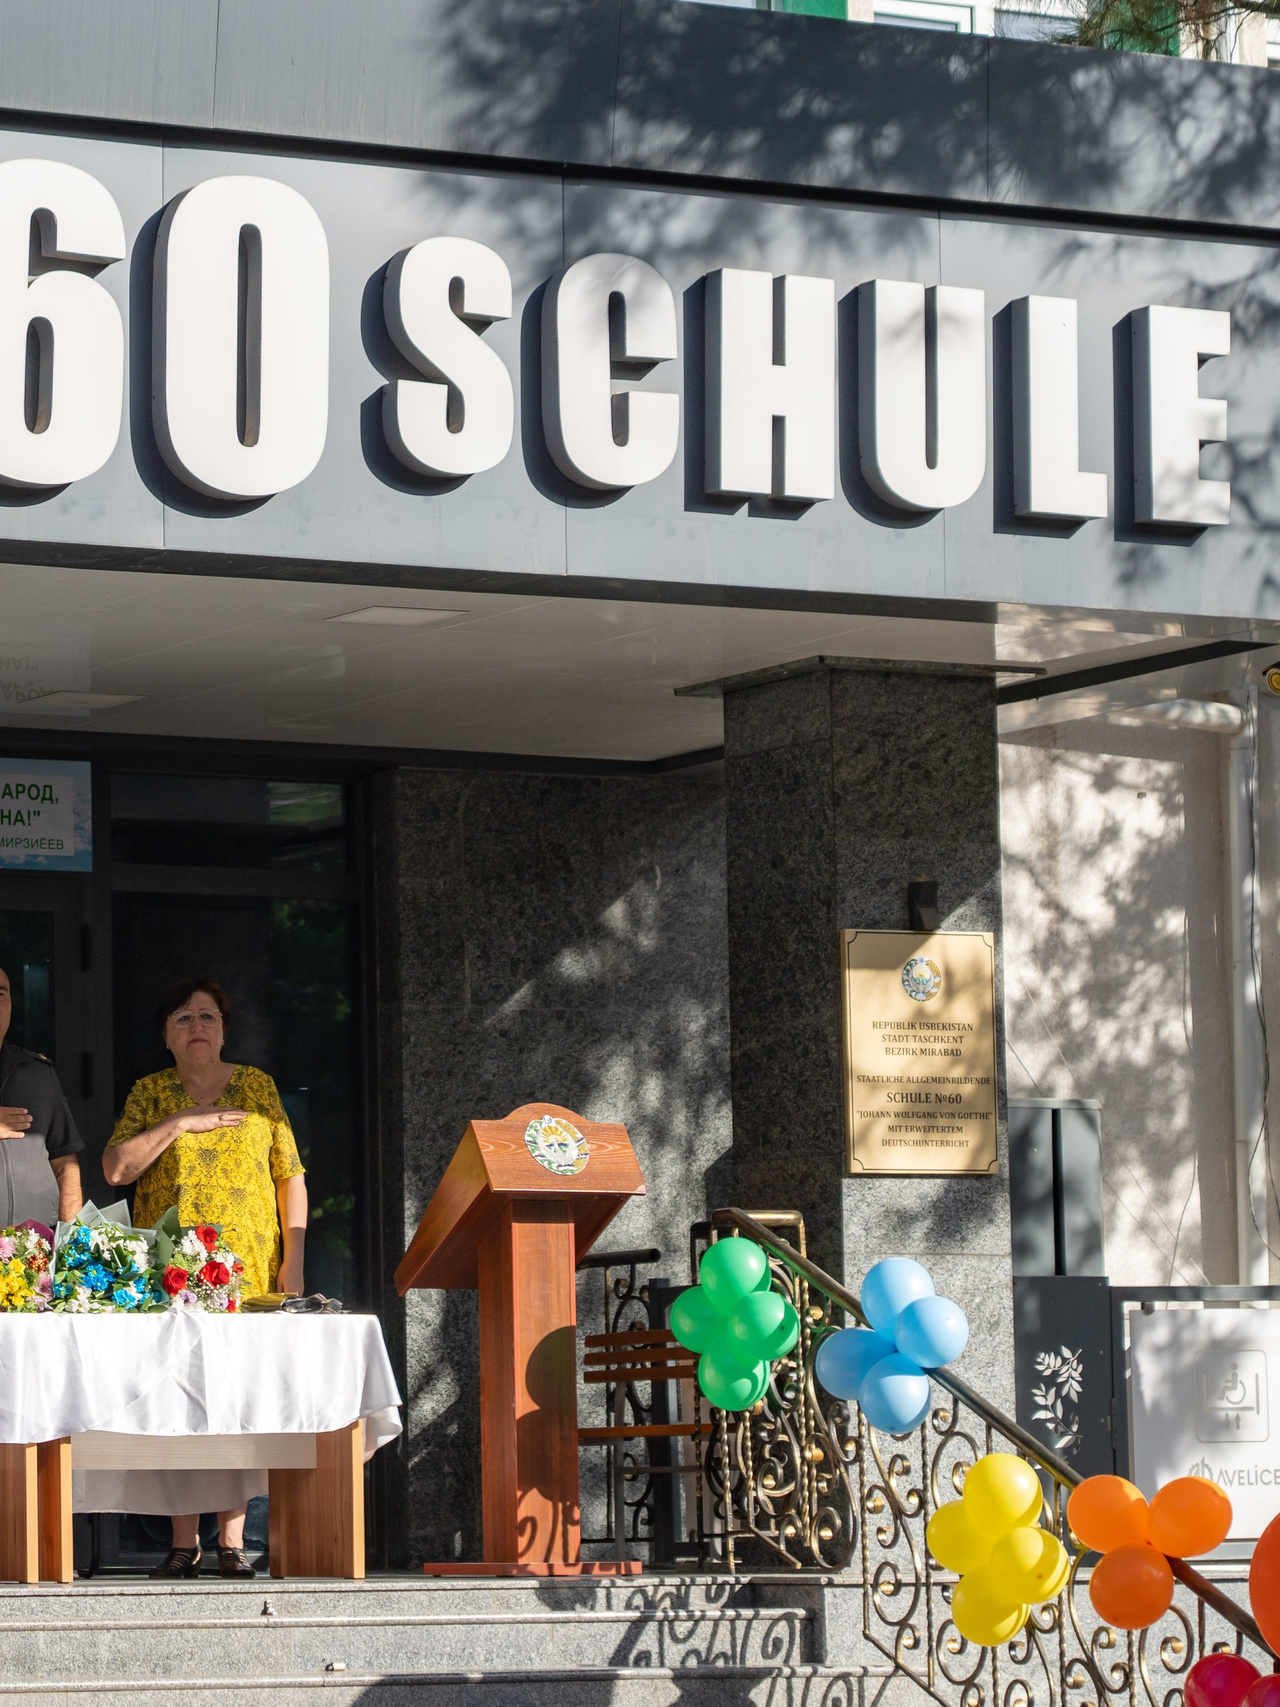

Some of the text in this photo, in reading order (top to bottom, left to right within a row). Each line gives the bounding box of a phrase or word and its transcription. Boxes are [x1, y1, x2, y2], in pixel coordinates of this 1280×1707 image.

[380, 236, 1233, 530] SCHULE
[872, 1020, 974, 1032] REPUBLIK USBEKISTAN
[881, 1034, 965, 1044] STADT TASCHKENT
[885, 1047, 962, 1057] BEZIRK MIRABAD
[856, 1074, 992, 1085] STAATLICHE ALLGEMEINBILDENDE
[886, 1091, 932, 1104] SCHULE
[893, 1110, 938, 1120] WOLFGANG
[939, 1111, 956, 1120] VON
[887, 1124, 963, 1134] MIT ERWEITERTEM
[881, 1138, 970, 1148] DEUTSCHUNTERRICHT
